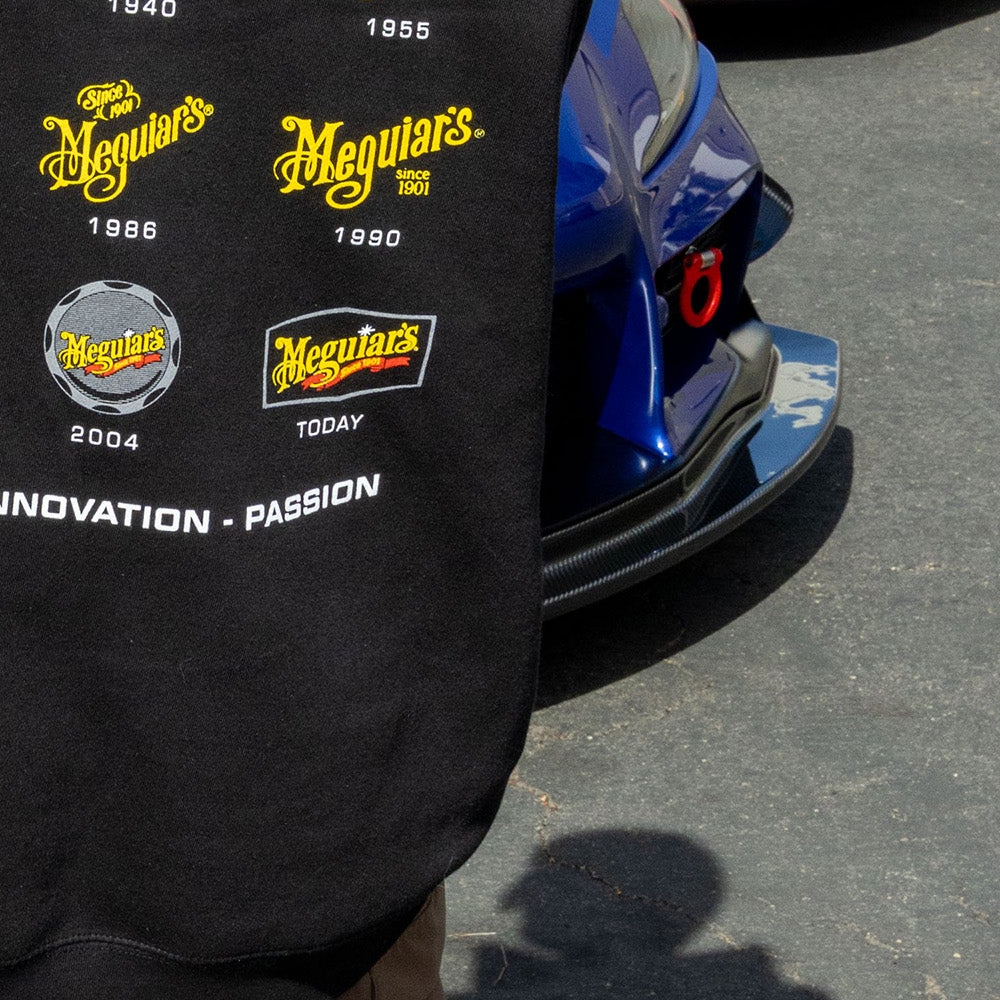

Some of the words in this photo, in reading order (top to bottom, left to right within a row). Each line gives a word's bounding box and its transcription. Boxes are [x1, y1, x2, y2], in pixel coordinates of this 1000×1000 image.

[366, 17, 430, 40] 1955
[39, 96, 206, 203] Meguiar's
[273, 106, 473, 209] Meguiar's
[396, 168, 430, 180] since
[398, 182, 430, 195] 1901
[88, 216, 157, 240] 1986
[334, 226, 401, 247] 1990
[58, 326, 166, 374] Meguiar's
[272, 322, 419, 393] Meguiar's
[70, 425, 139, 451] 2004
[296, 413, 364, 439] TODAY
[245, 473, 381, 532] PASSION
